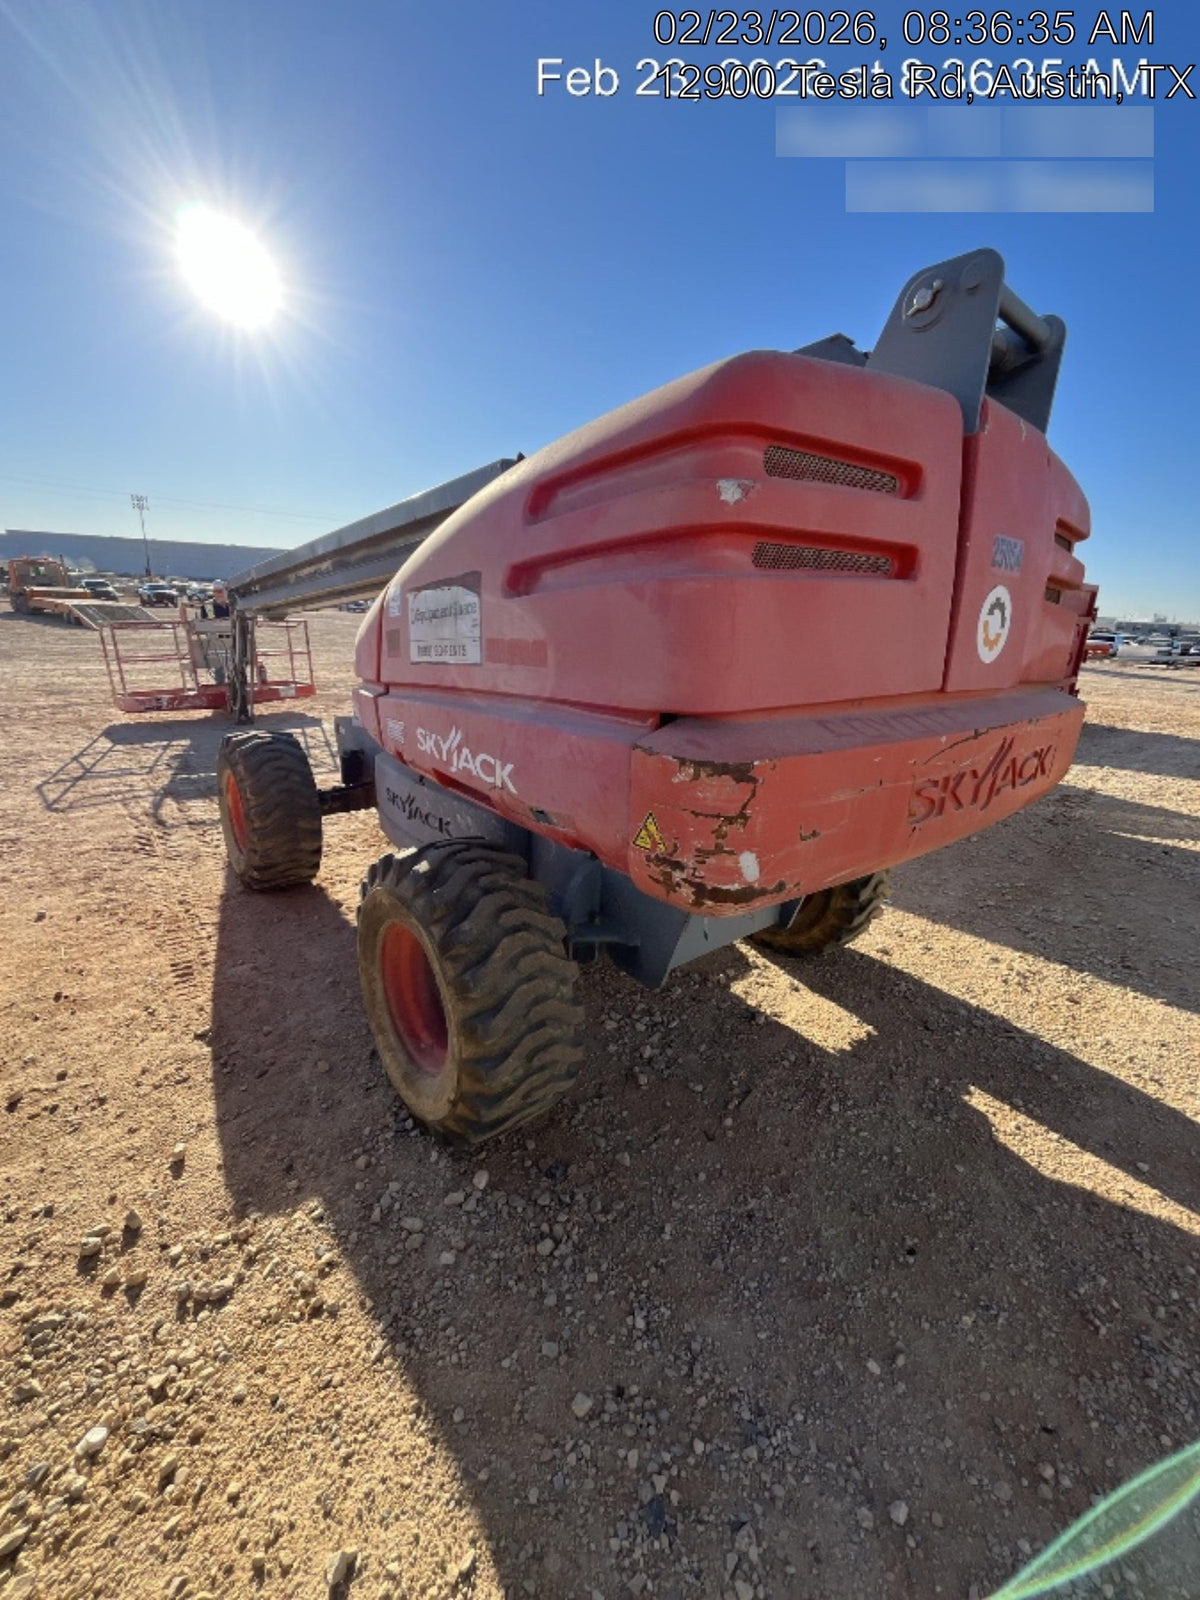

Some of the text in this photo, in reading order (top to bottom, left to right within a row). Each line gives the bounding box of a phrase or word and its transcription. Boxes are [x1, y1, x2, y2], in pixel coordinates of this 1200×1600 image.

[416, 725, 518, 795] SKYJACK
[906, 735, 1053, 825] SKYJACK
[386, 787, 454, 838] SKYJACK
